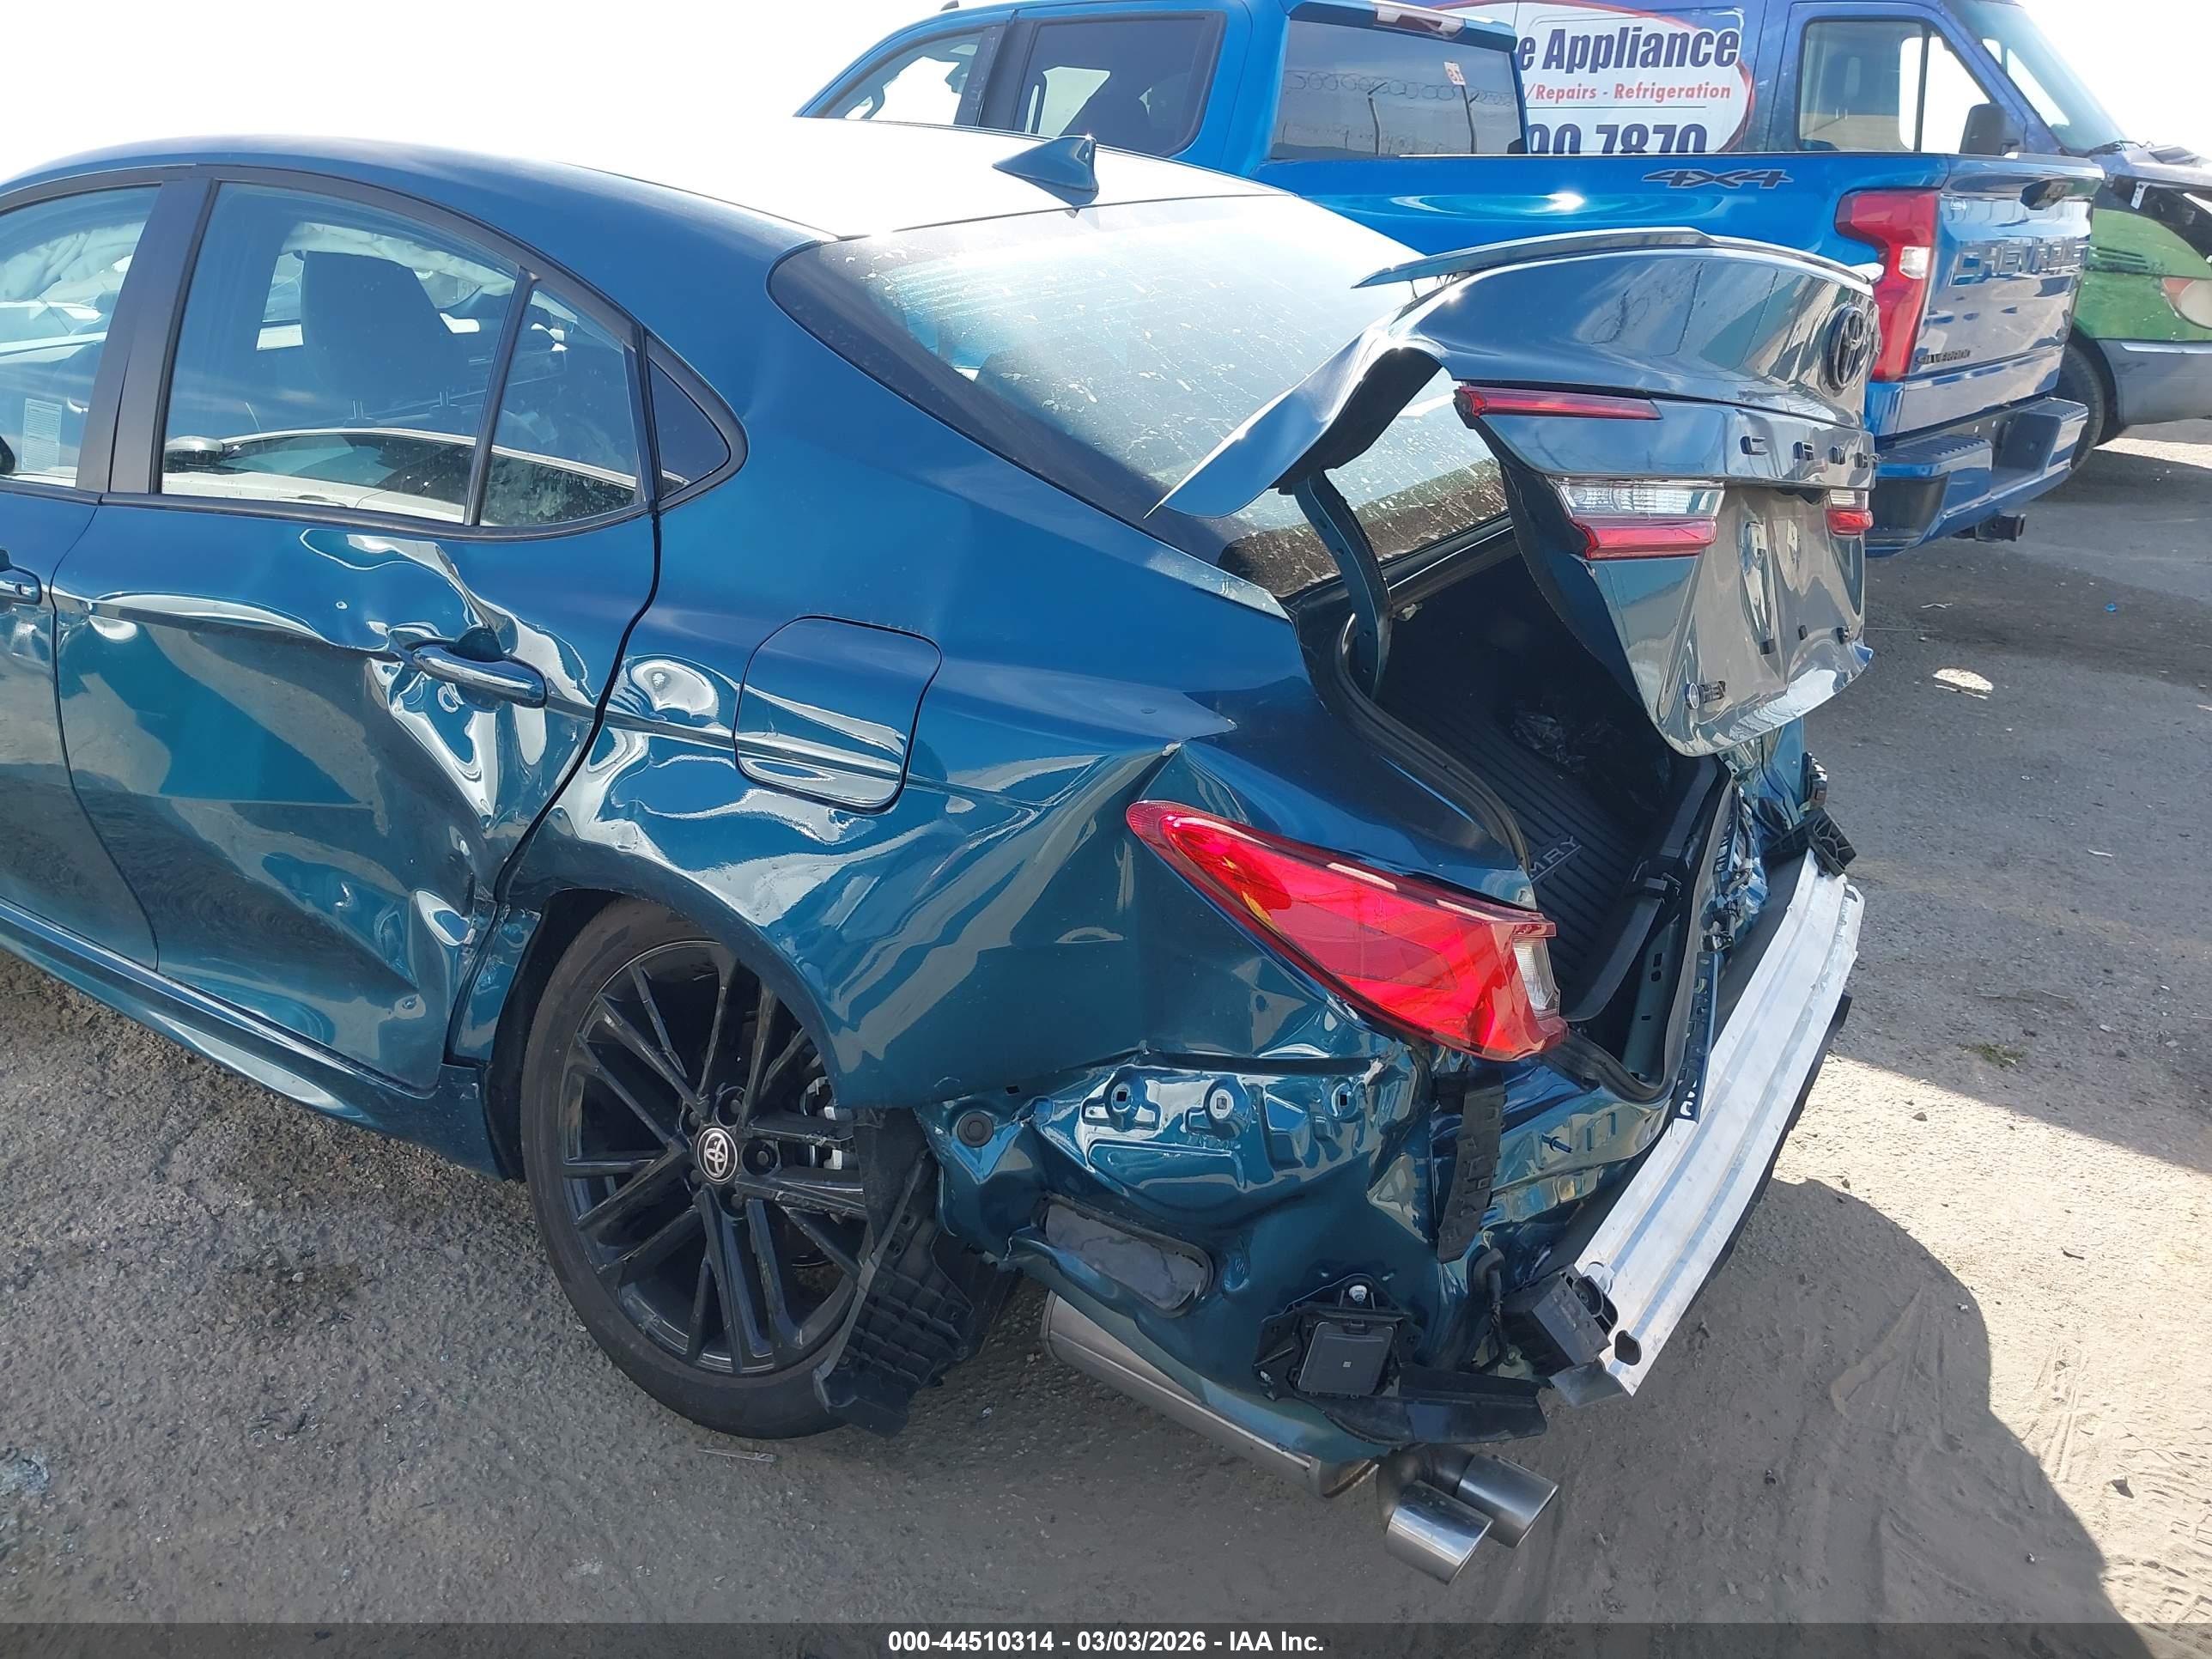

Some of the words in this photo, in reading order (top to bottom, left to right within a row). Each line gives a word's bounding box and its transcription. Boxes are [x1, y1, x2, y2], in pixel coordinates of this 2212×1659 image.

[1542, 27, 1740, 74] Appliance
[1523, 83, 1596, 104] /Repairs
[1614, 82, 1731, 103] Refrigeration
[1595, 123, 1708, 155] 7870
